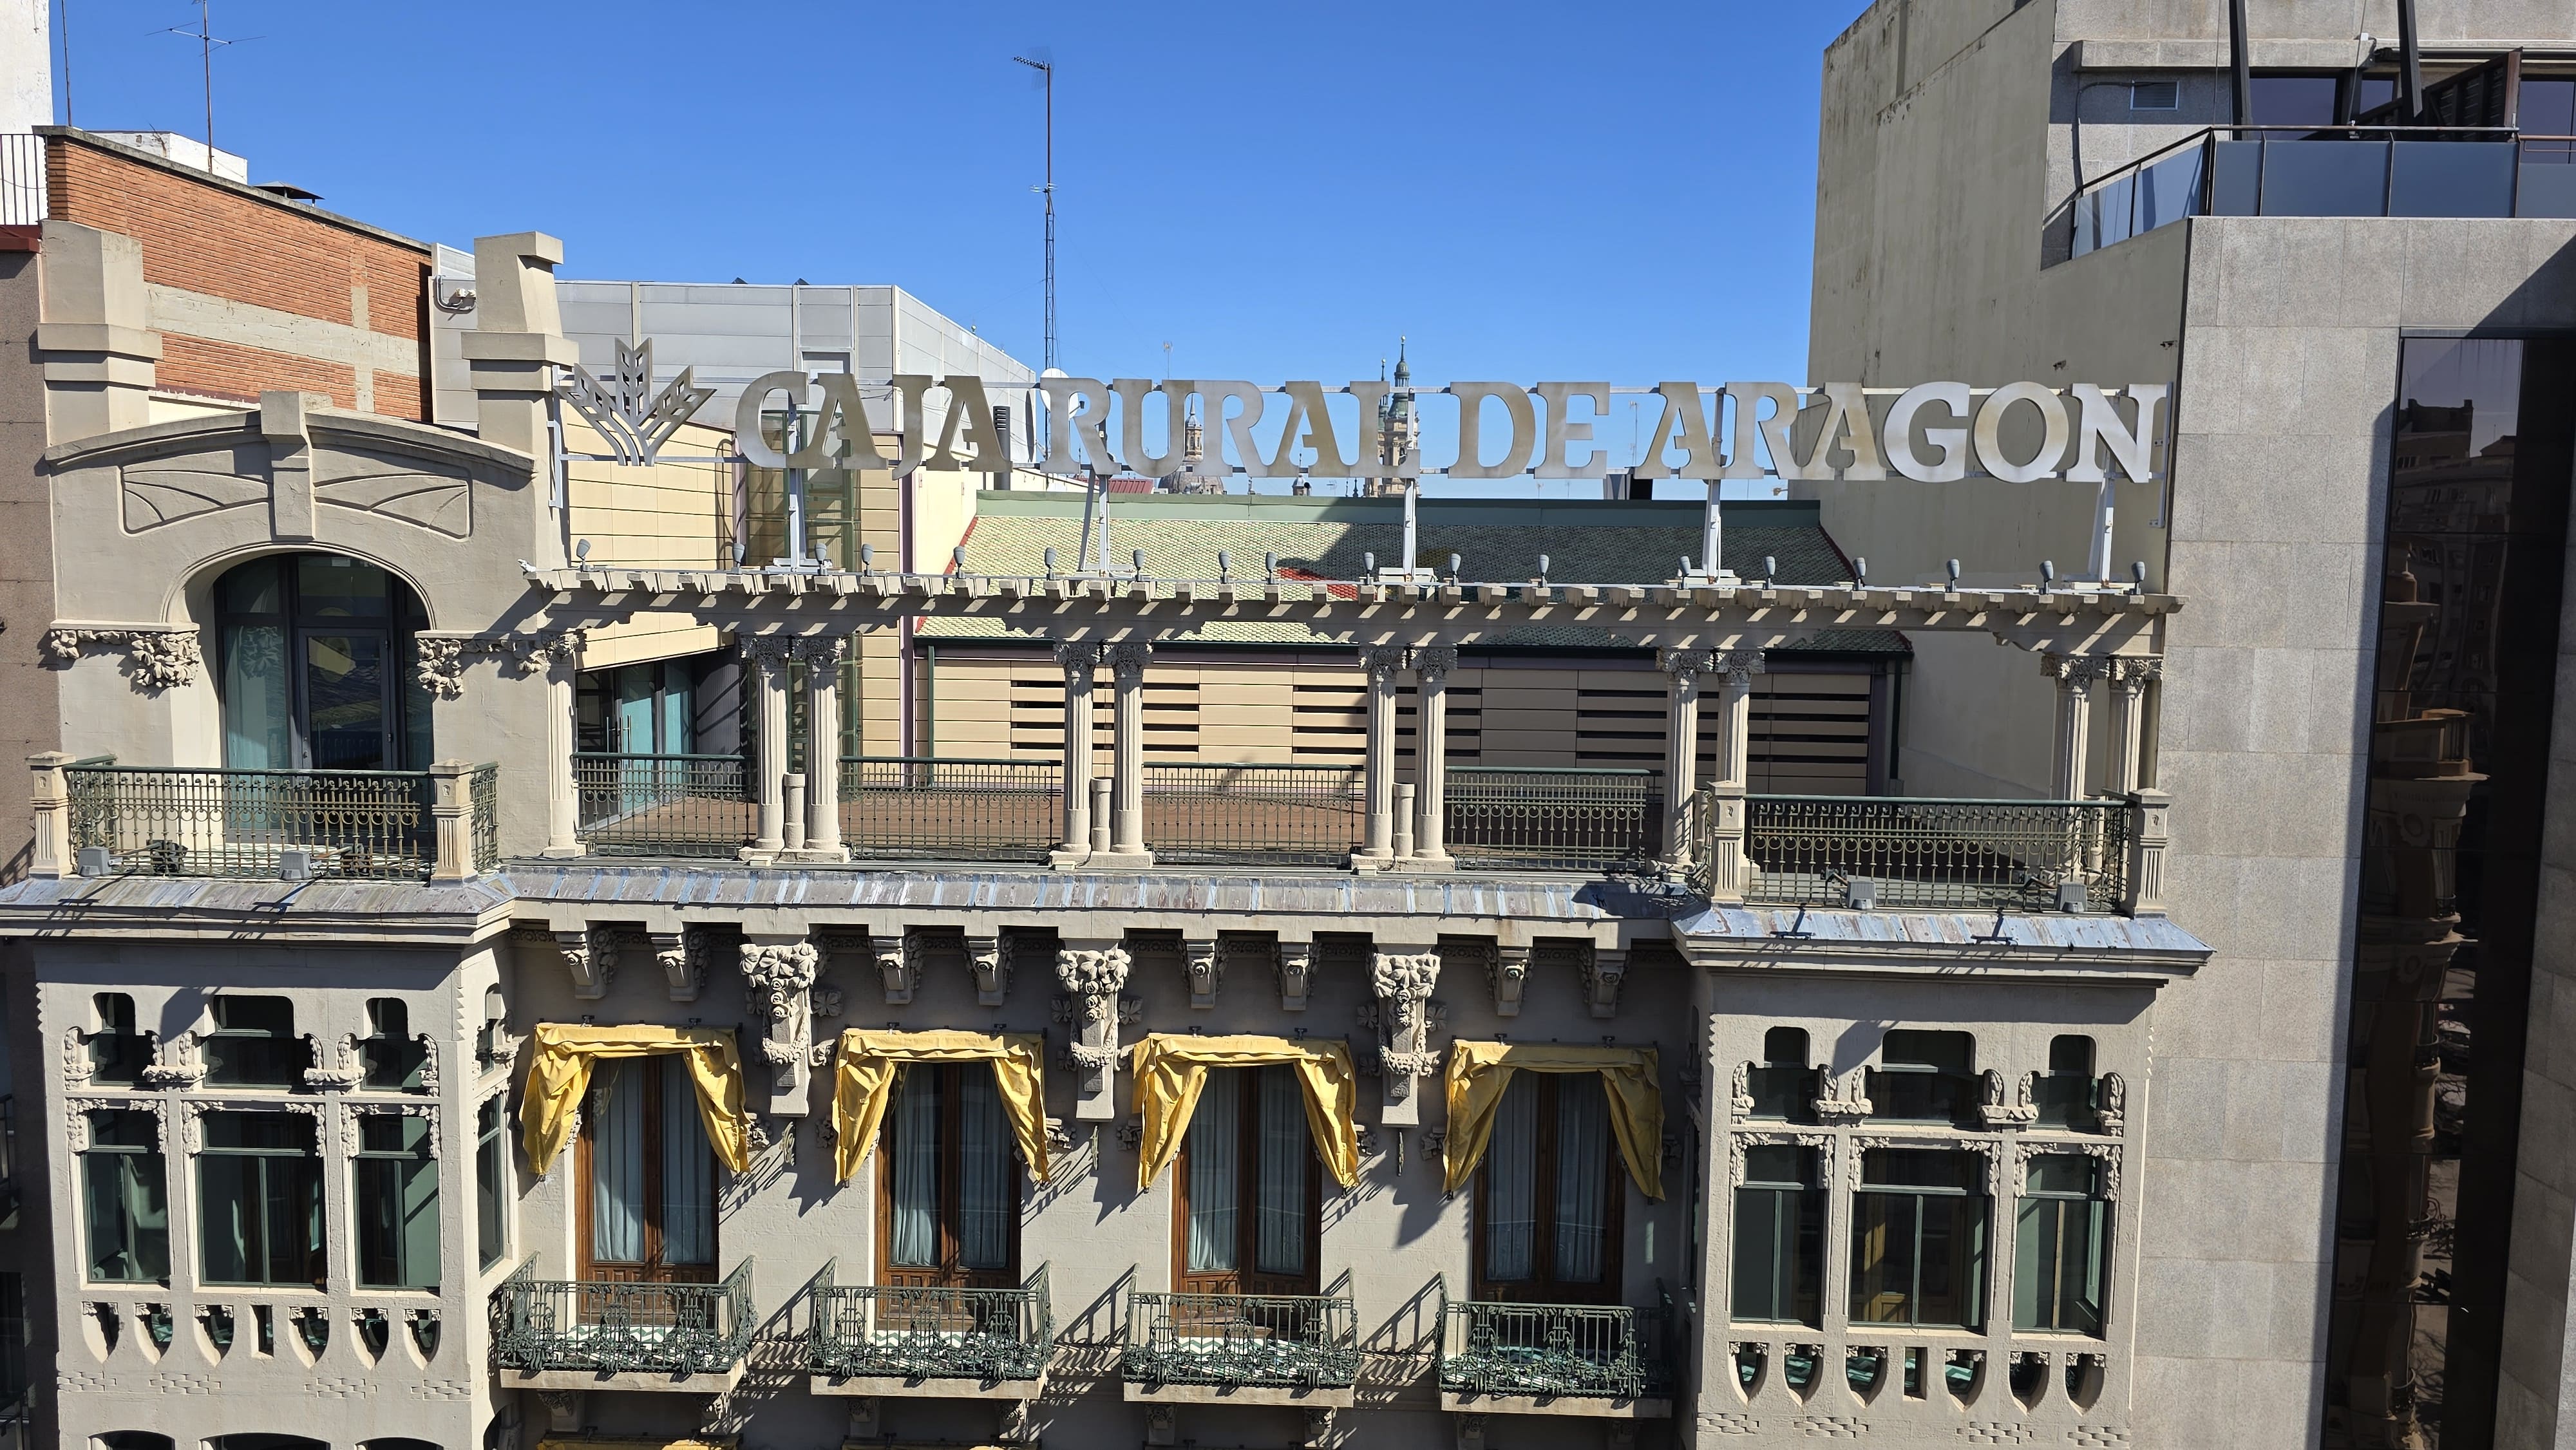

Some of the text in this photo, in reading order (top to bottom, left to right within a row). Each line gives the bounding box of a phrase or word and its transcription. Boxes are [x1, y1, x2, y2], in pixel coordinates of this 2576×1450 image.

[735, 370, 2166, 484] CAJA RURAL DE ARAGON
